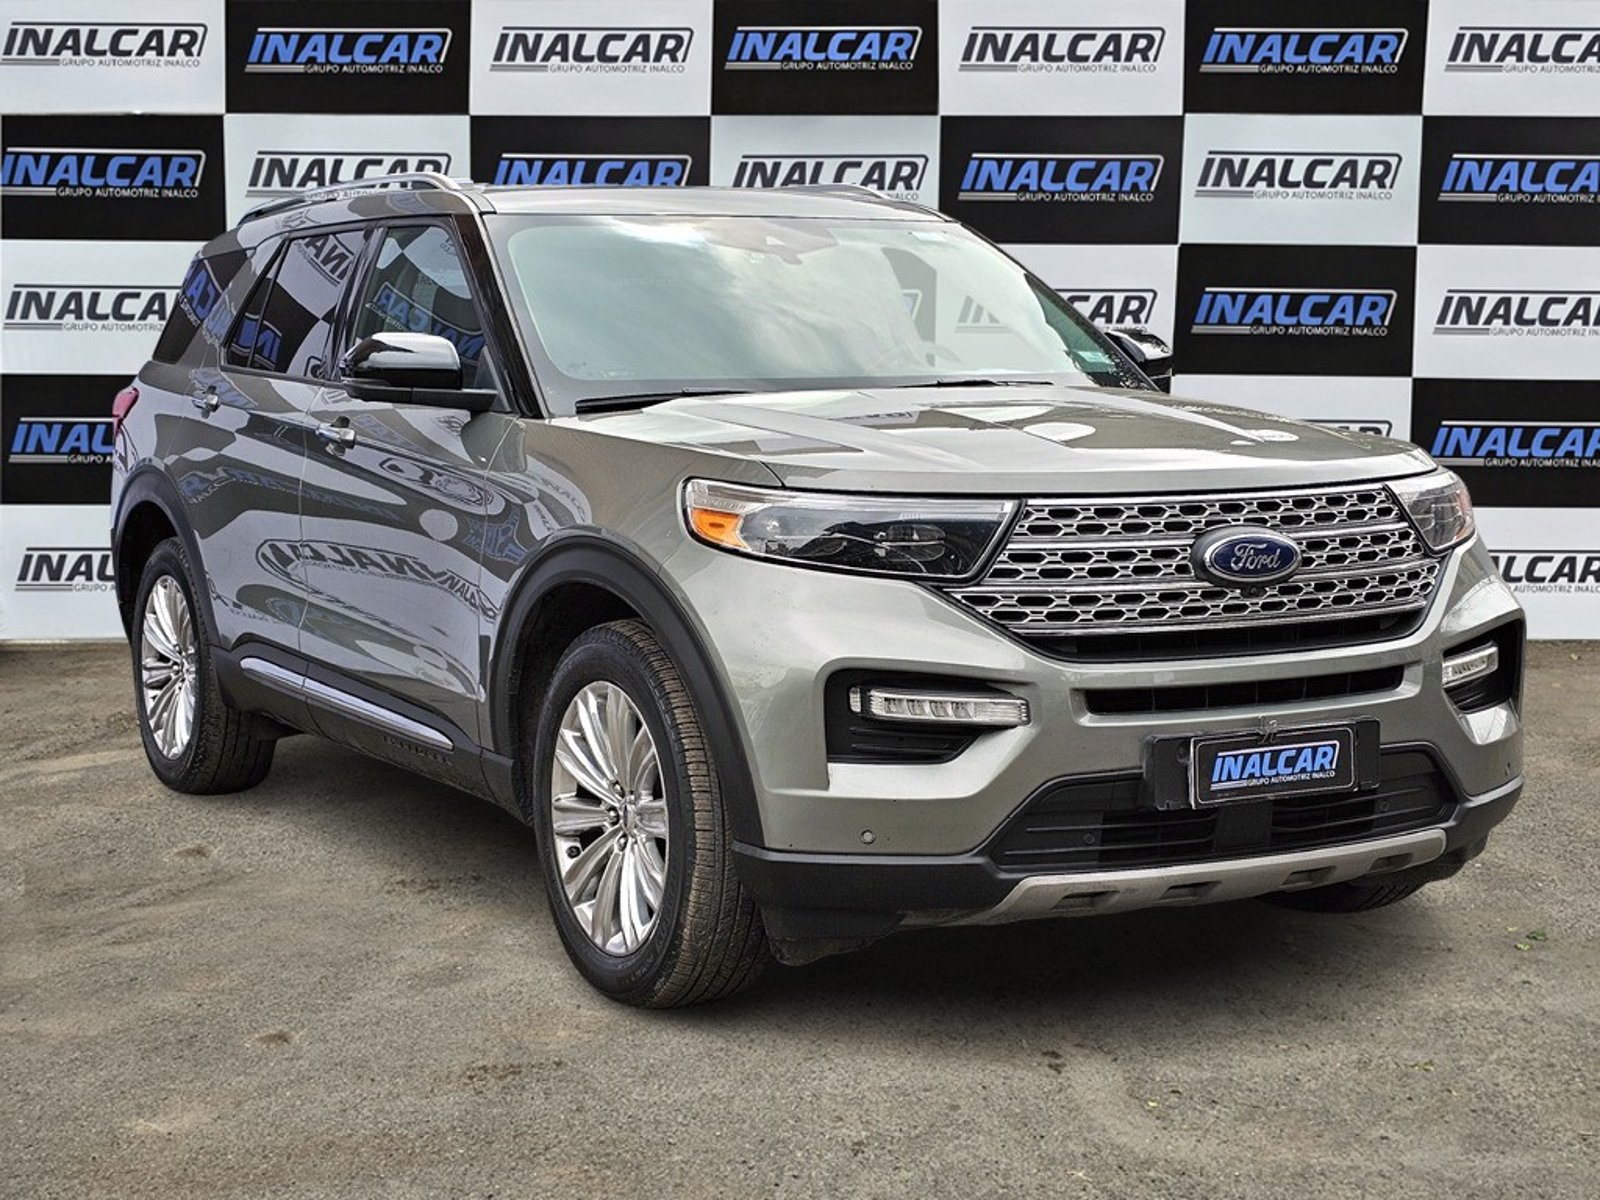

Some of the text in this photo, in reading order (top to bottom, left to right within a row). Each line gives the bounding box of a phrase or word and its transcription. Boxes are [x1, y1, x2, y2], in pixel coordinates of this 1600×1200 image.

[3, 28, 199, 57] INALCAR
[727, 32, 914, 61] INALCAR
[248, 34, 443, 63] INALCAR
[493, 33, 685, 63] INALCAR
[961, 33, 1156, 63] INALCAR
[1202, 34, 1399, 63] INALCAR
[62, 58, 200, 68] GRUPO AUTOMOTRIZ INALCO
[781, 62, 914, 70] GRUPO AUTOMOTRIZ INALCO
[305, 64, 443, 73] GRUPO AUTOMOTRIZ INALCO
[550, 64, 685, 73] GRUPO AUTOMOTRIZ INALCO
[1019, 64, 1156, 73] GRUPO AUTOMOTRIZ INALCO
[1260, 64, 1398, 73] GRUPO AUTOMOTRIZ INALCO
[1503, 65, 1538, 74] GRUPO
[1, 155, 197, 187] INALCAR
[493, 160, 683, 187] INALCAR
[732, 161, 919, 191] INALCAR
[960, 160, 1155, 192] INALCAR
[1198, 157, 1393, 188] INALCAR
[57, 187, 198, 198] GRUPO AUTOMOTRIZ INALCO
[1017, 193, 1154, 201] GRUPO AUTOMOTRIZ INALCO
[1253, 191, 1392, 200] GRUPO AUTOMOTRIZ INALCO
[1498, 194, 1531, 203] GRUPO
[1533, 194, 1594, 203] AUTOMOTRIZ
[5, 290, 180, 321] INALCA
[1194, 293, 1388, 326] INALCAR
[1435, 296, 1600, 326] INALCA
[63, 323, 98, 332] GRUPO
[1251, 326, 1388, 336] GRUPO AUTOMOTRIZ INALCO
[1491, 328, 1524, 337] GRUPO
[1526, 328, 1586, 337] AUTOMOTRIZ
[69, 455, 104, 463] GRUPO
[1486, 458, 1517, 467] GRUPO
[1519, 458, 1579, 467] AUTOMOTRIZ
[1231, 544, 1280, 571] Ford
[74, 584, 107, 592] GRUPO
[1514, 585, 1572, 594] AUTOMOTRIZ
[1212, 747, 1334, 782] INALCAR
